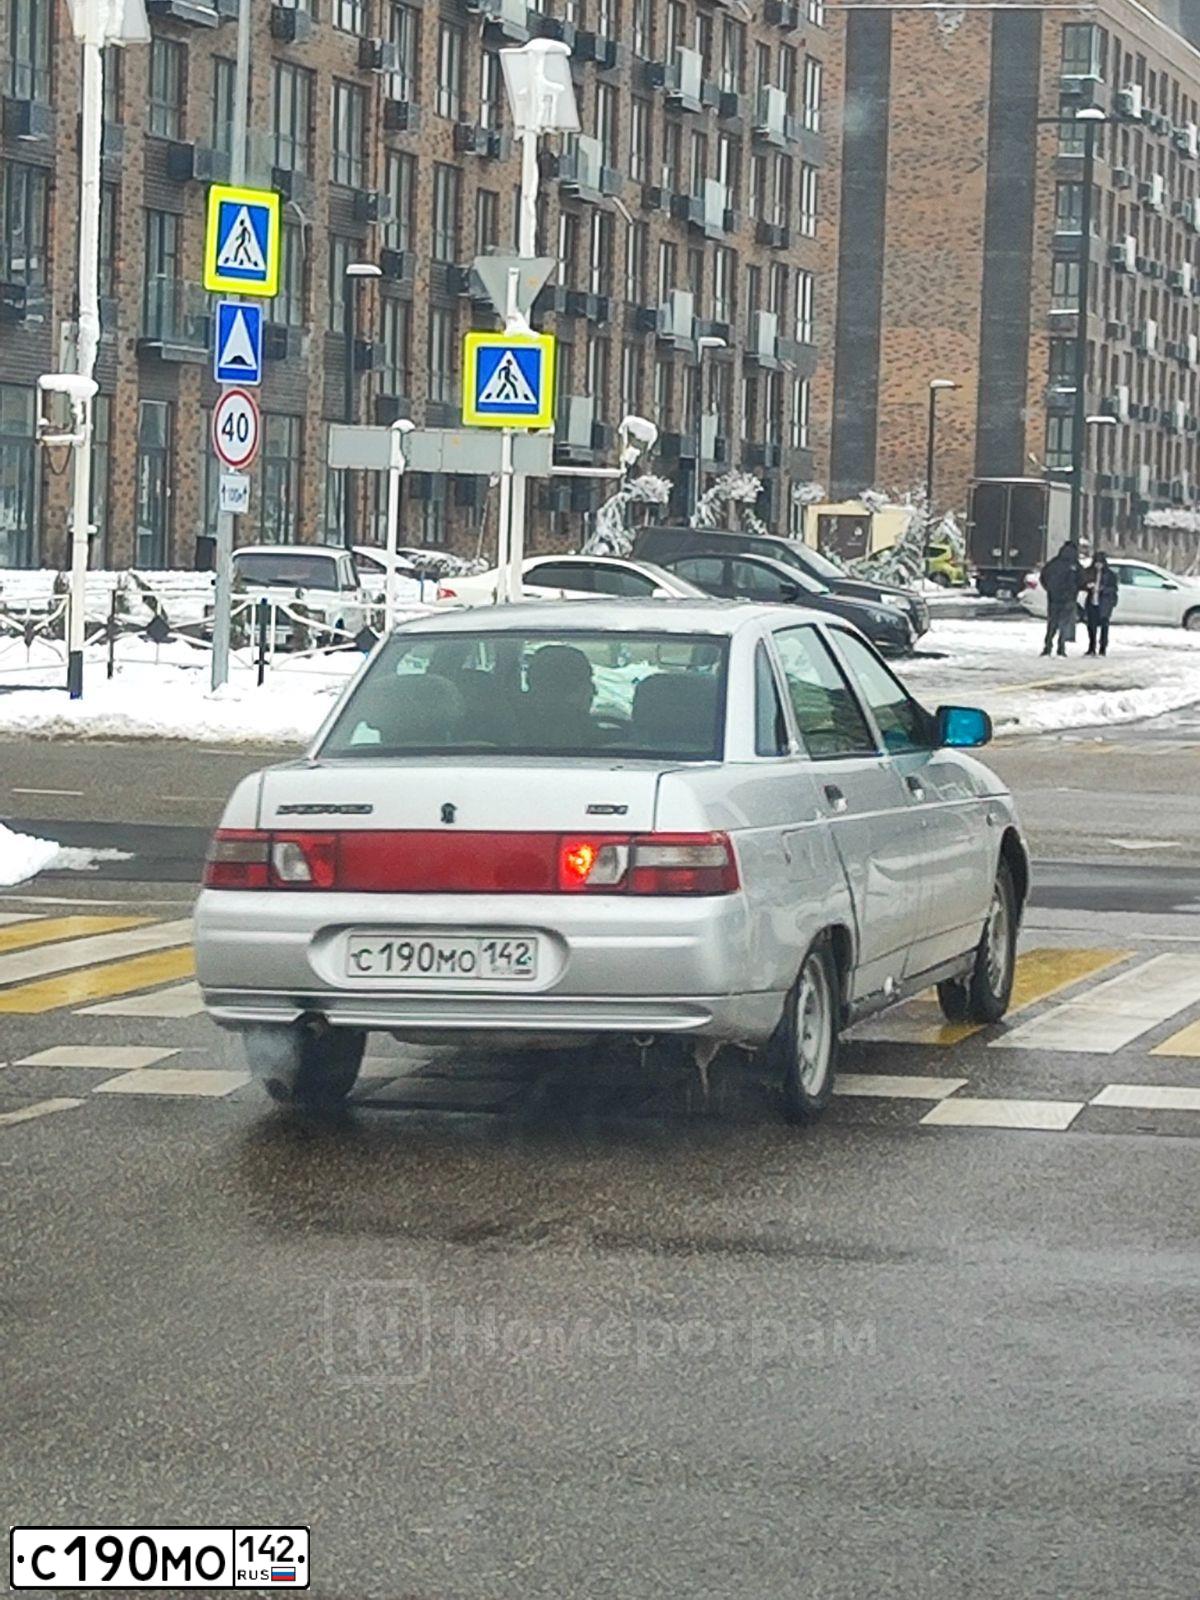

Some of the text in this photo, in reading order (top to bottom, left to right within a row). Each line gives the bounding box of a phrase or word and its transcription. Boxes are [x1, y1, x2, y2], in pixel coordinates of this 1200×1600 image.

[222, 412, 249, 443] 40
[355, 942, 530, 972] С190МО 142
